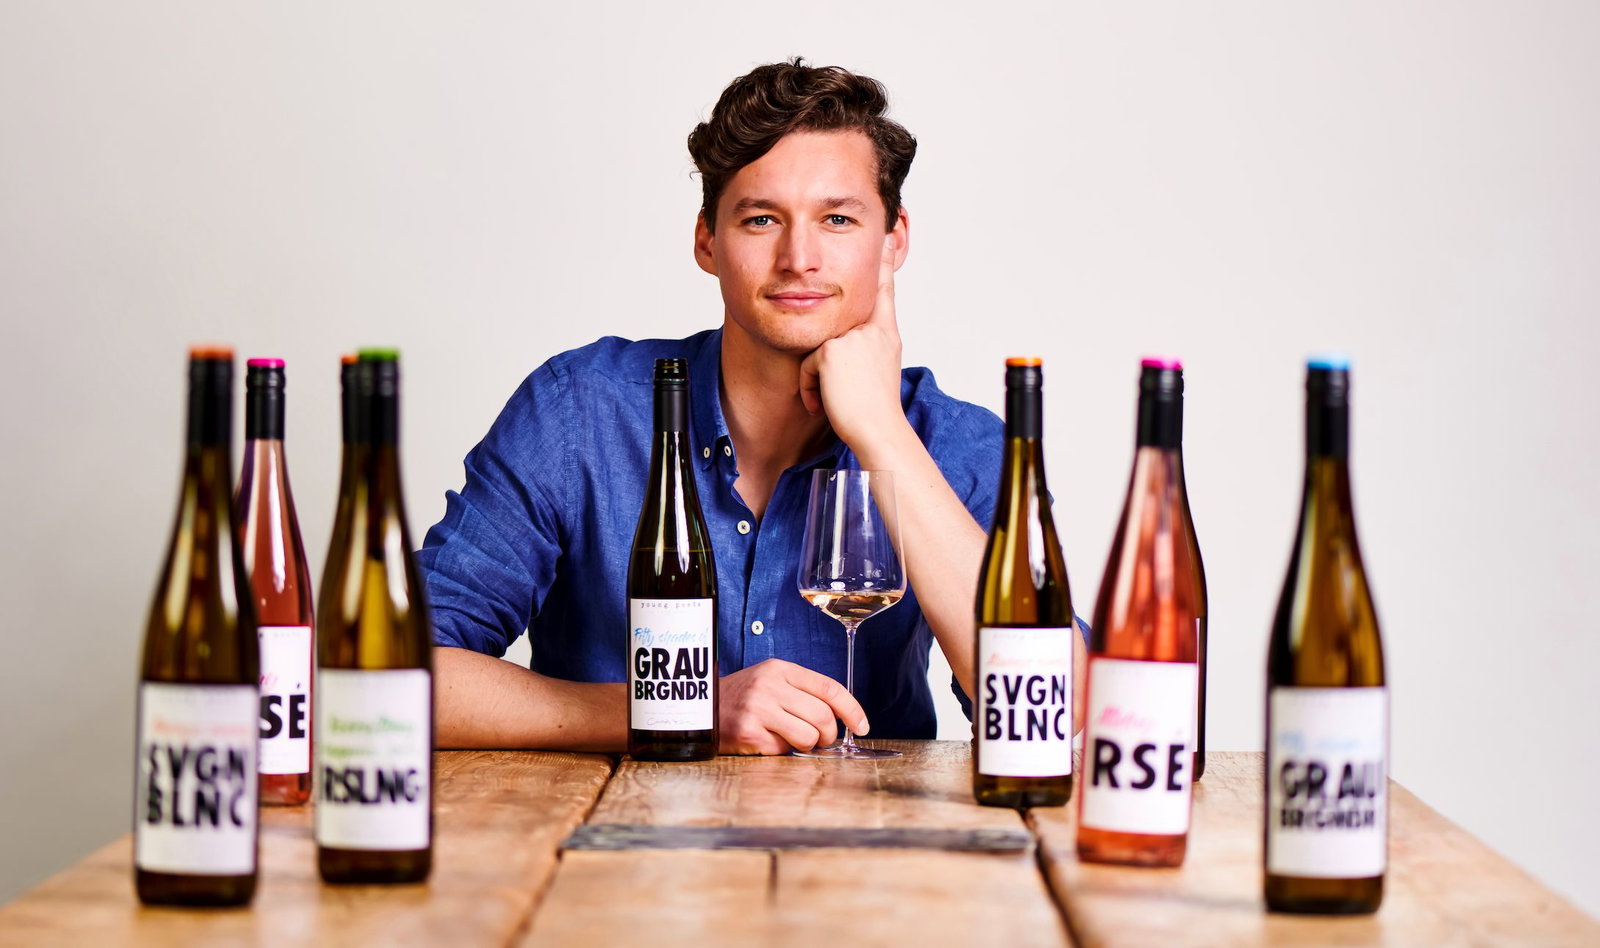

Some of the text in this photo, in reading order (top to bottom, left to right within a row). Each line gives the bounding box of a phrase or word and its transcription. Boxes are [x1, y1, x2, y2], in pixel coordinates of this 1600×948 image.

[634, 647, 709, 680] GRAU
[634, 680, 709, 701] BRGNDR
[985, 673, 1066, 706] SVGN
[985, 707, 1066, 741] BLNC
[146, 744, 246, 783] SVGN
[147, 786, 245, 828] BLNC
